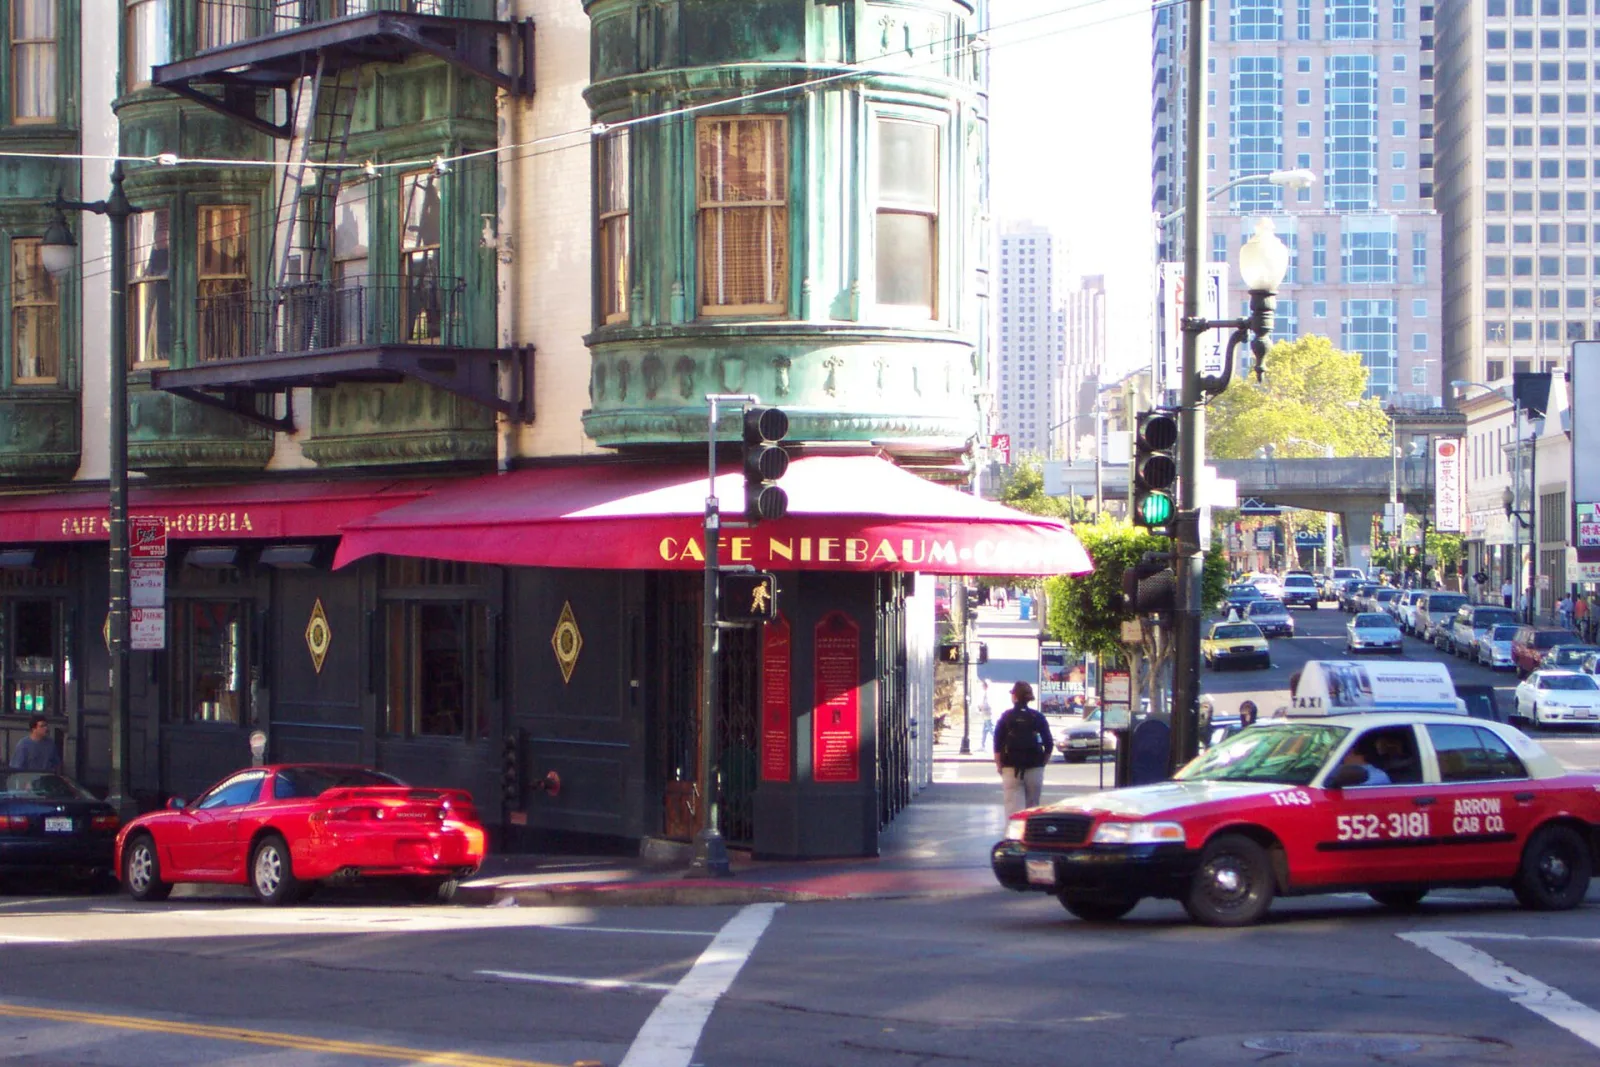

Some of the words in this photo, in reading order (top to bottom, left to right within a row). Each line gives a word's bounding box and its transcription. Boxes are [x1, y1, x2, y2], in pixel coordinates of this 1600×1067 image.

[62, 516, 97, 535] CAFE
[131, 609, 141, 620] NO
[143, 611, 164, 620] PARKING
[1041, 681, 1061, 691] SAVE
[1292, 696, 1322, 709] TAXI
[1270, 791, 1312, 806] 1143
[1454, 798, 1501, 815] ARROW
[1453, 816, 1480, 834] CAB
